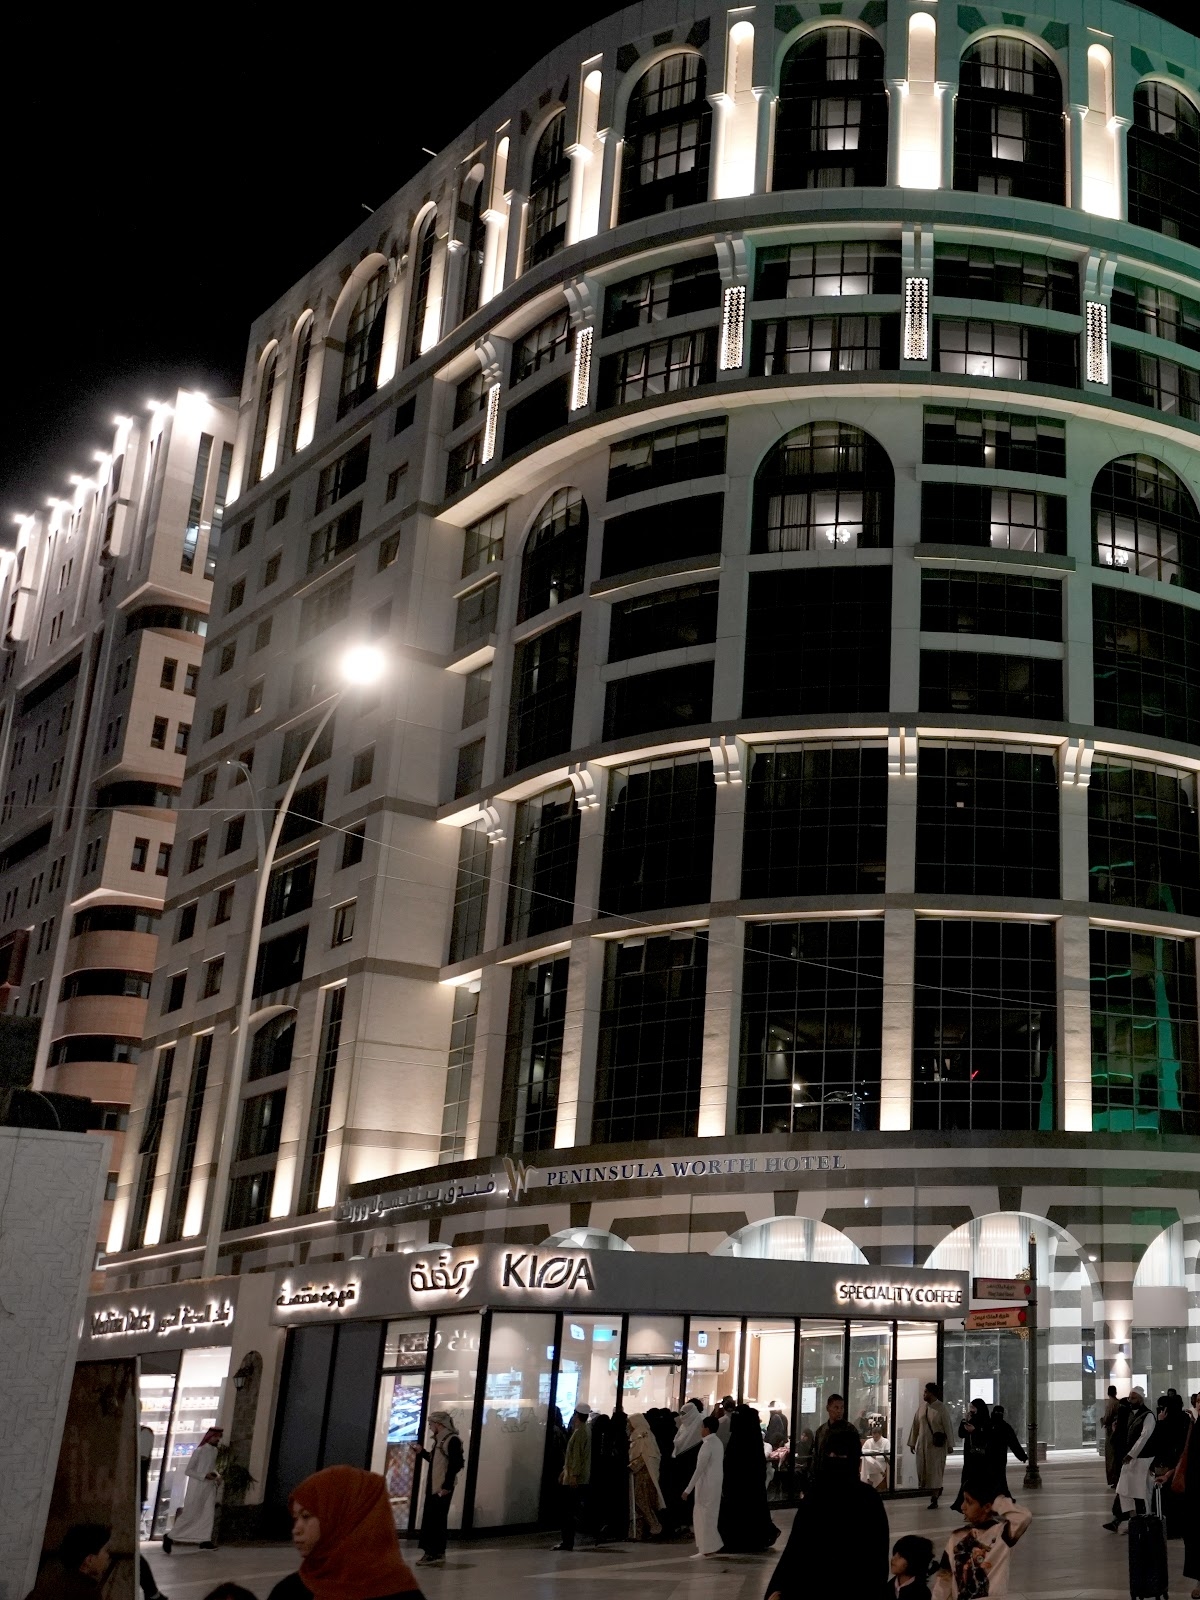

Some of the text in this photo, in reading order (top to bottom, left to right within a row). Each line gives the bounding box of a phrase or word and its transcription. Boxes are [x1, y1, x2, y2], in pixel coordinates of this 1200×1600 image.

[547, 1154, 847, 1186] PENINSULA WORTH HOTEL
[443, 1173, 496, 1205] فندق
[839, 1284, 963, 1304] SPECIALITY COFFEE
